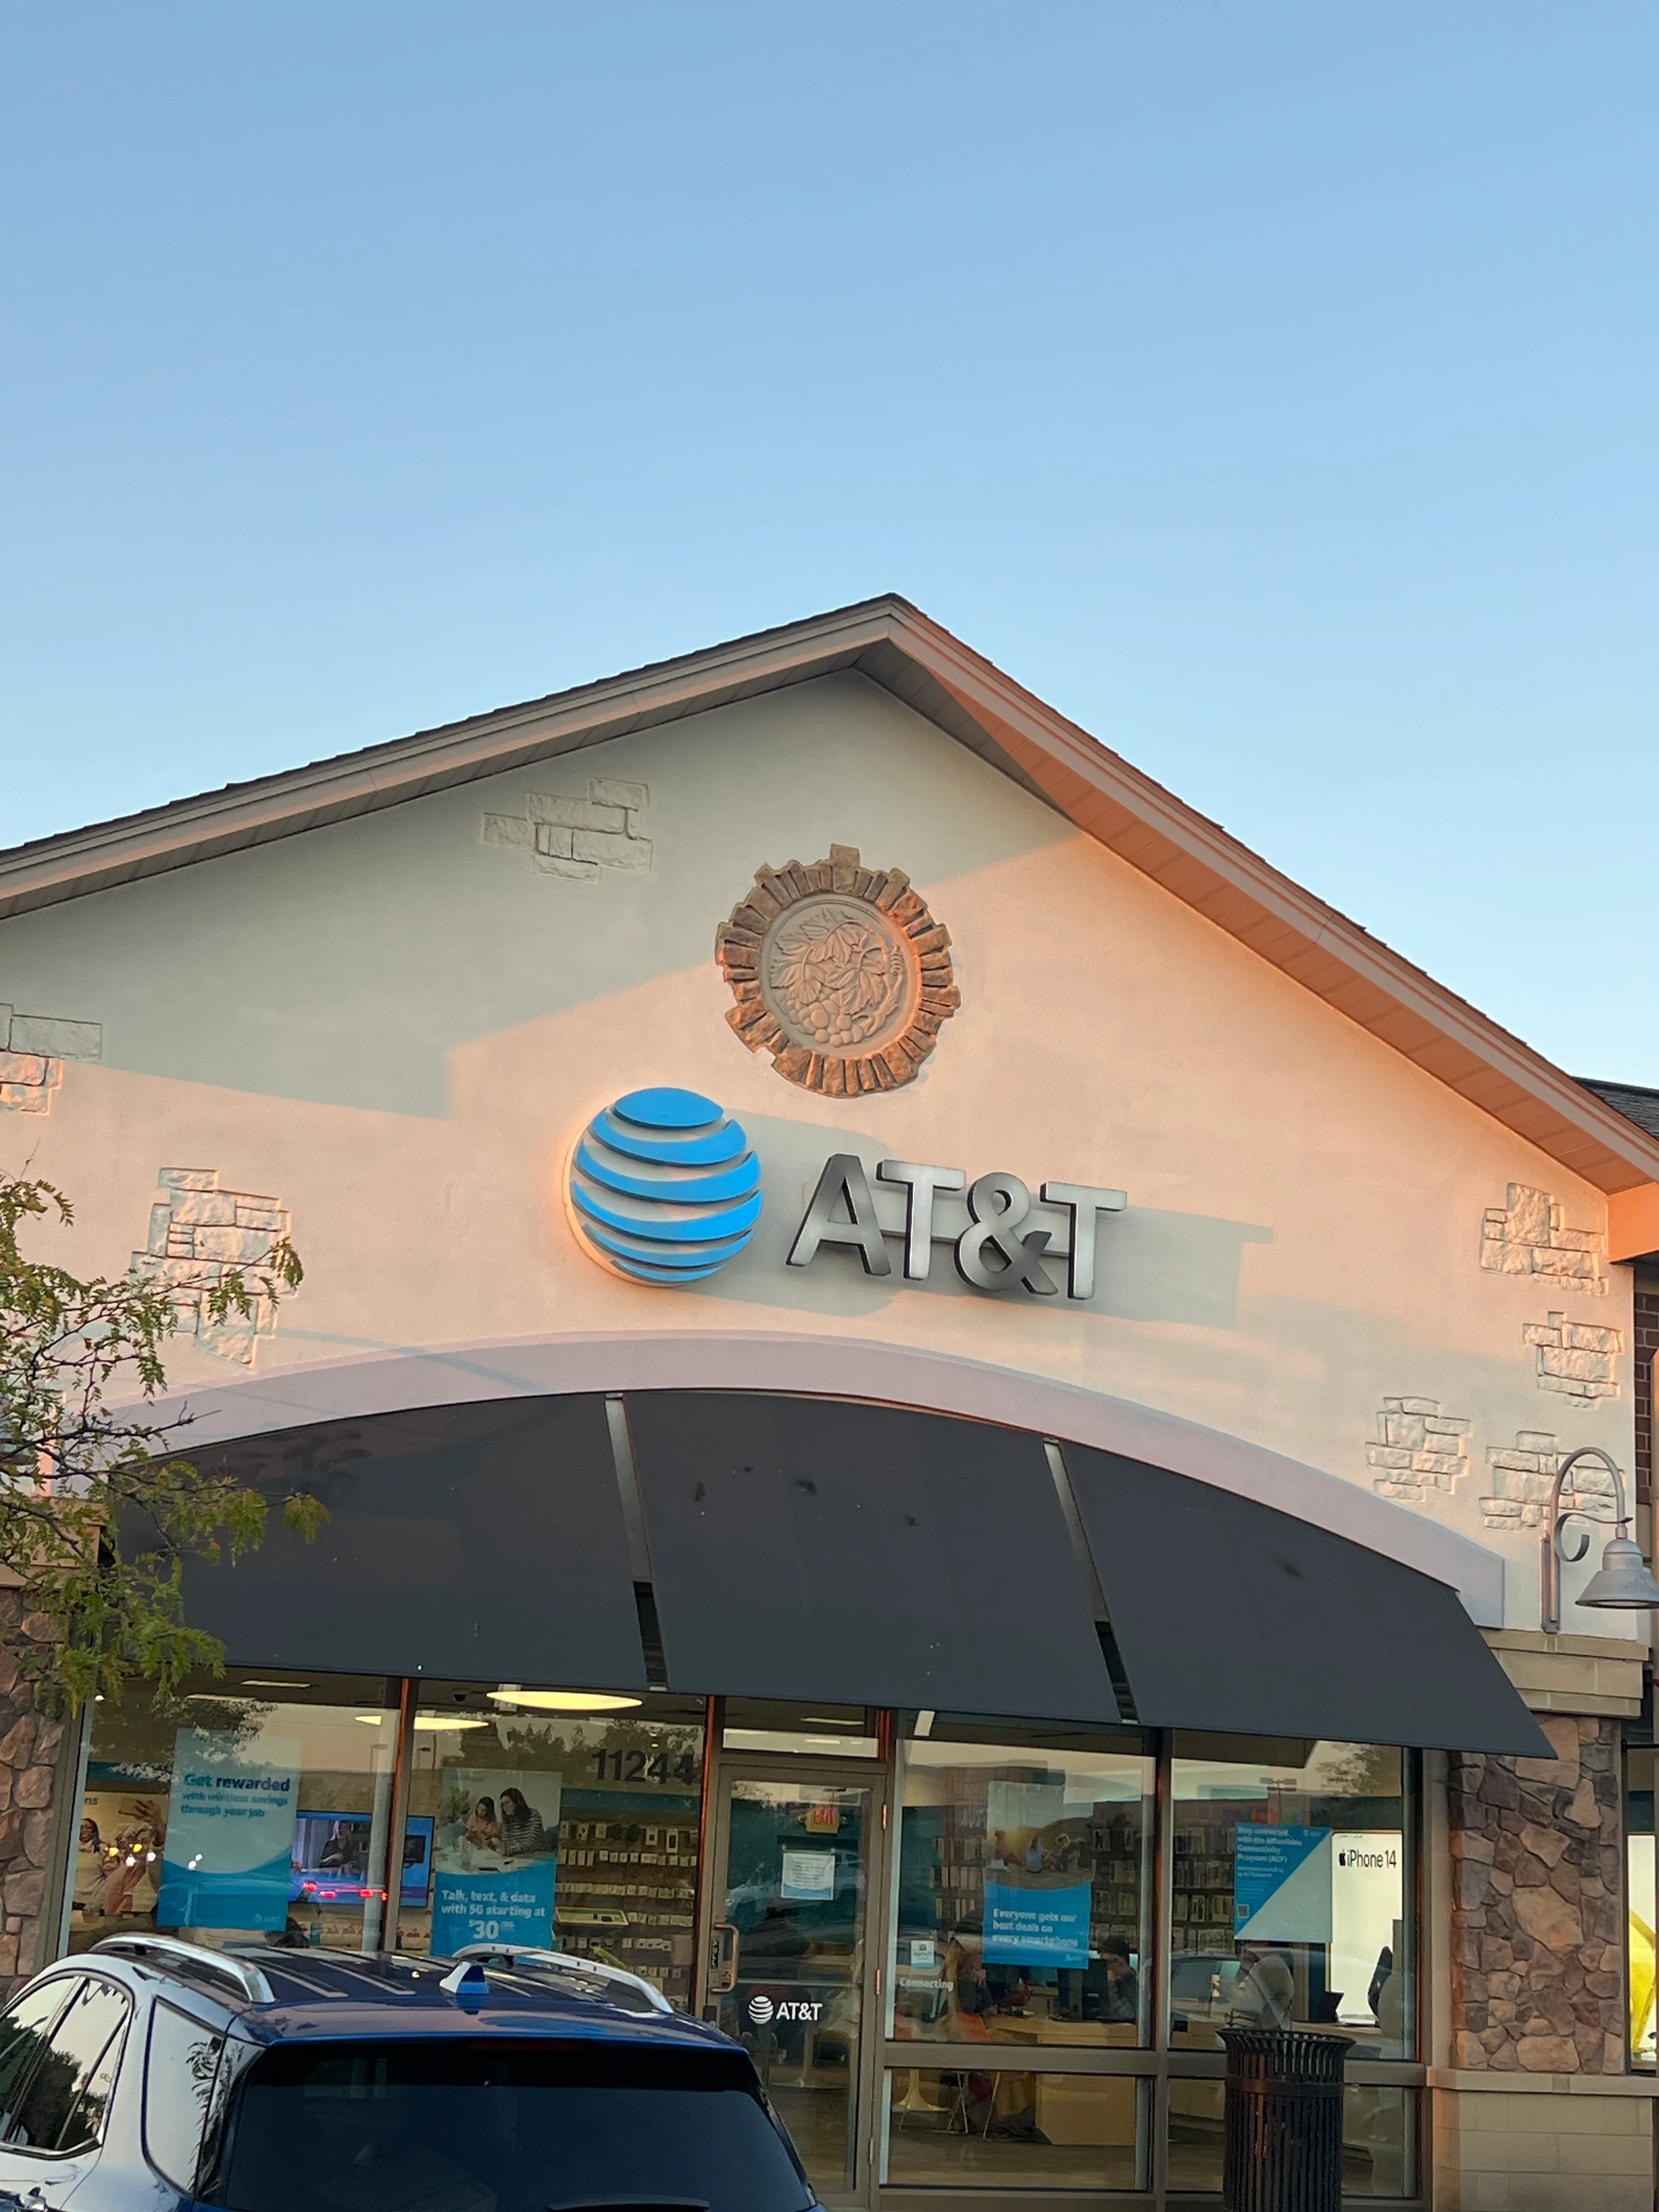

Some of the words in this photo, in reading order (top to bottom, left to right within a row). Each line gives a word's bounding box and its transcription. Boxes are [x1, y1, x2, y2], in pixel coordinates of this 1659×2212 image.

[786, 1153, 1127, 1300] AT&T
[591, 1748, 696, 1785] 11244
[184, 1773, 213, 1787] Get
[216, 1776, 290, 1792] rewarded
[1347, 1849, 1384, 1868] iPhone
[1384, 1849, 1397, 1869] 14
[510, 1892, 536, 1903] data
[533, 1907, 546, 1917] at
[776, 2002, 823, 2021] AT&T
